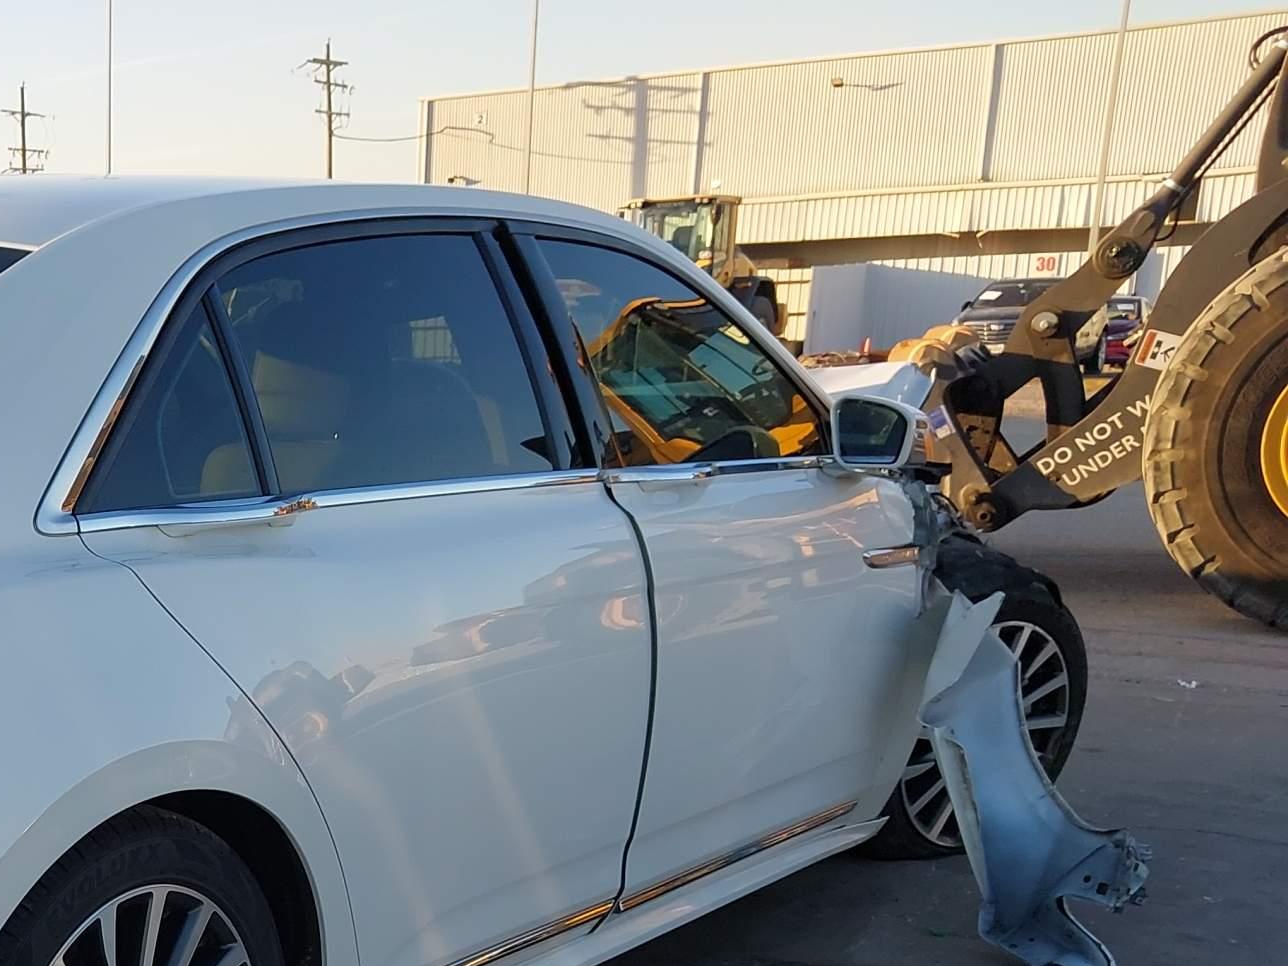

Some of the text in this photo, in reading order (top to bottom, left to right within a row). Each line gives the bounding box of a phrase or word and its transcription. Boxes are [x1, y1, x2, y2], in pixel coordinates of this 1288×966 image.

[477, 114, 484, 124] 2
[1035, 256, 1056, 272] 30
[1036, 446, 1072, 476] DO
[1074, 412, 1124, 452] NOT
[1061, 434, 1141, 487] UNDER
